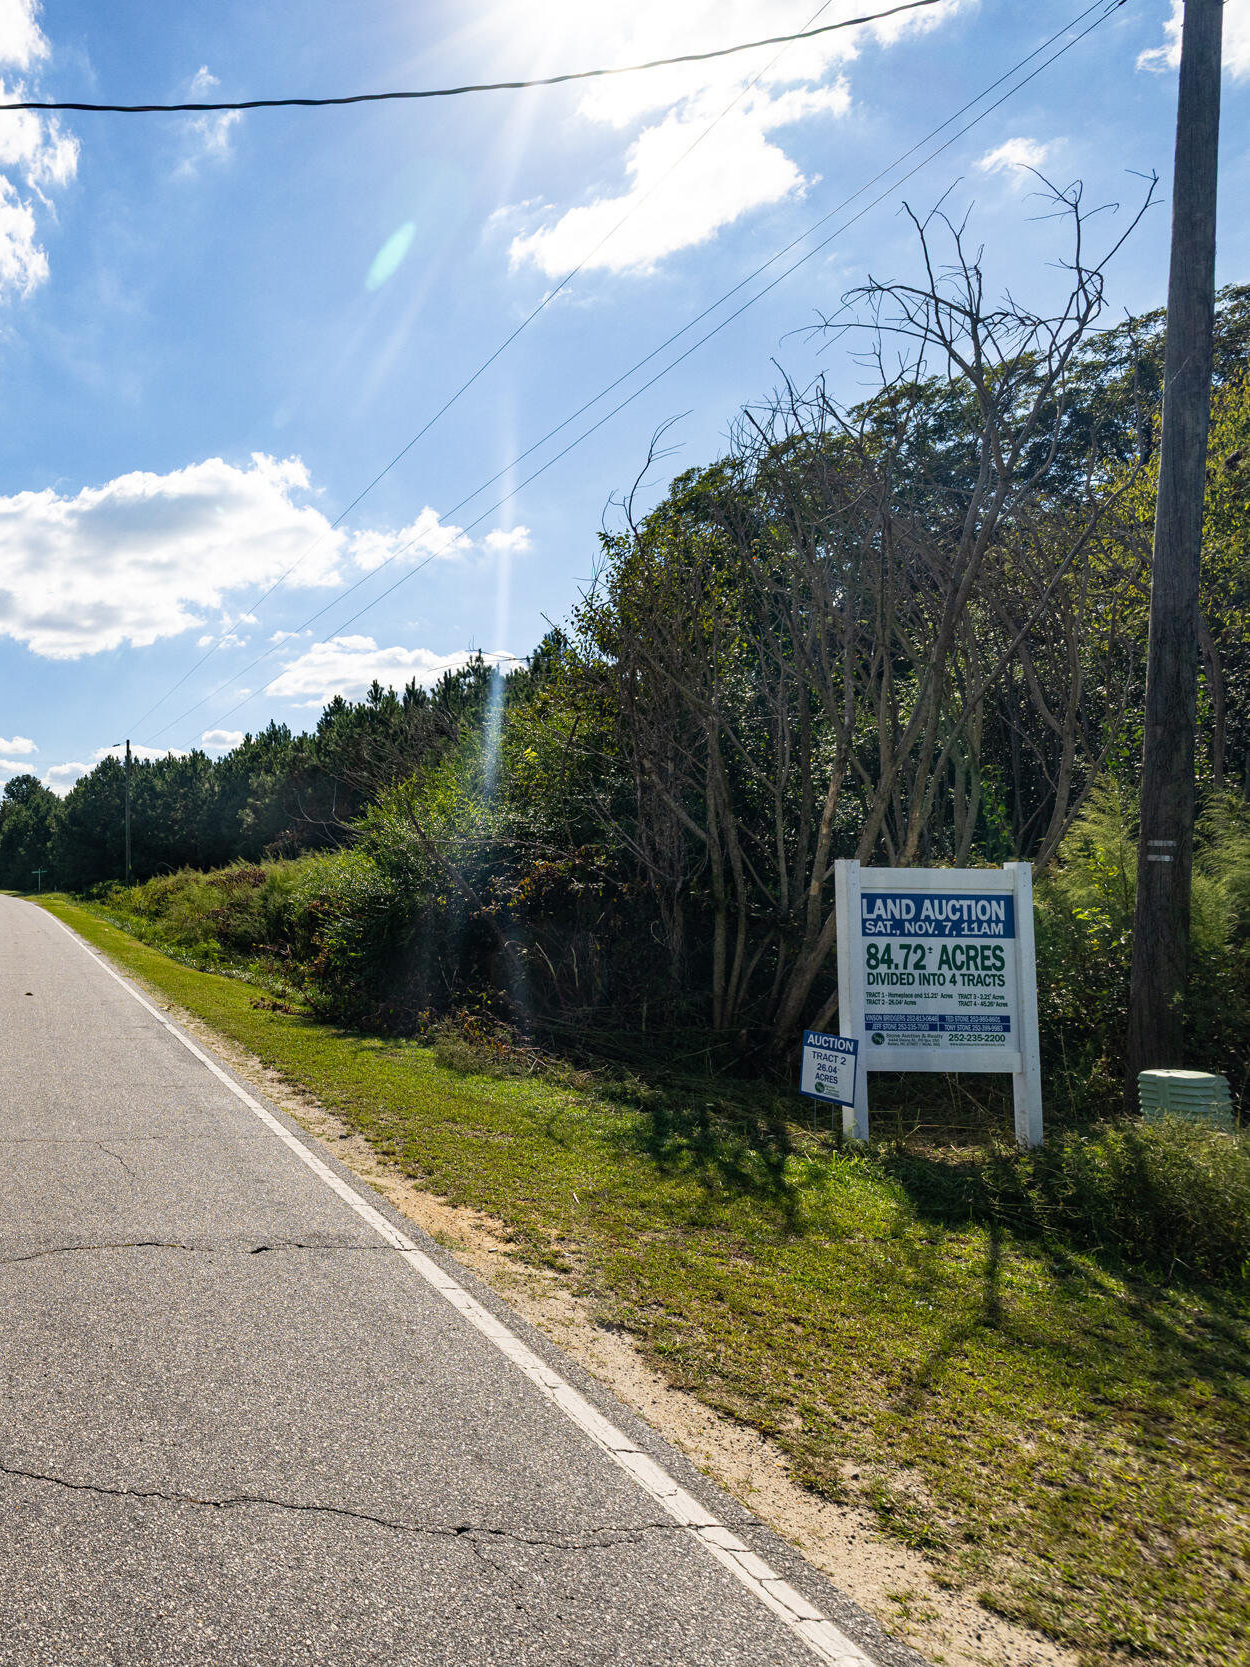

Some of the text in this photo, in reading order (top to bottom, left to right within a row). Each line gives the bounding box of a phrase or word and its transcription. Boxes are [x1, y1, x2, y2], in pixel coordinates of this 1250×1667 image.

[862, 898, 1005, 921] LAND AUCTION
[865, 921, 1004, 937] SAT., NOV. 7, 11AM
[937, 944, 1006, 972] ACRES
[867, 972, 1006, 988] DIVIDED INTO 4 TRACTS
[866, 991, 881, 999] TRACT
[807, 1033, 854, 1053] AUCTION
[948, 1033, 1006, 1042] 252-235-2200
[812, 1050, 847, 1066] TRACT 2
[815, 1072, 839, 1085] ACRES
